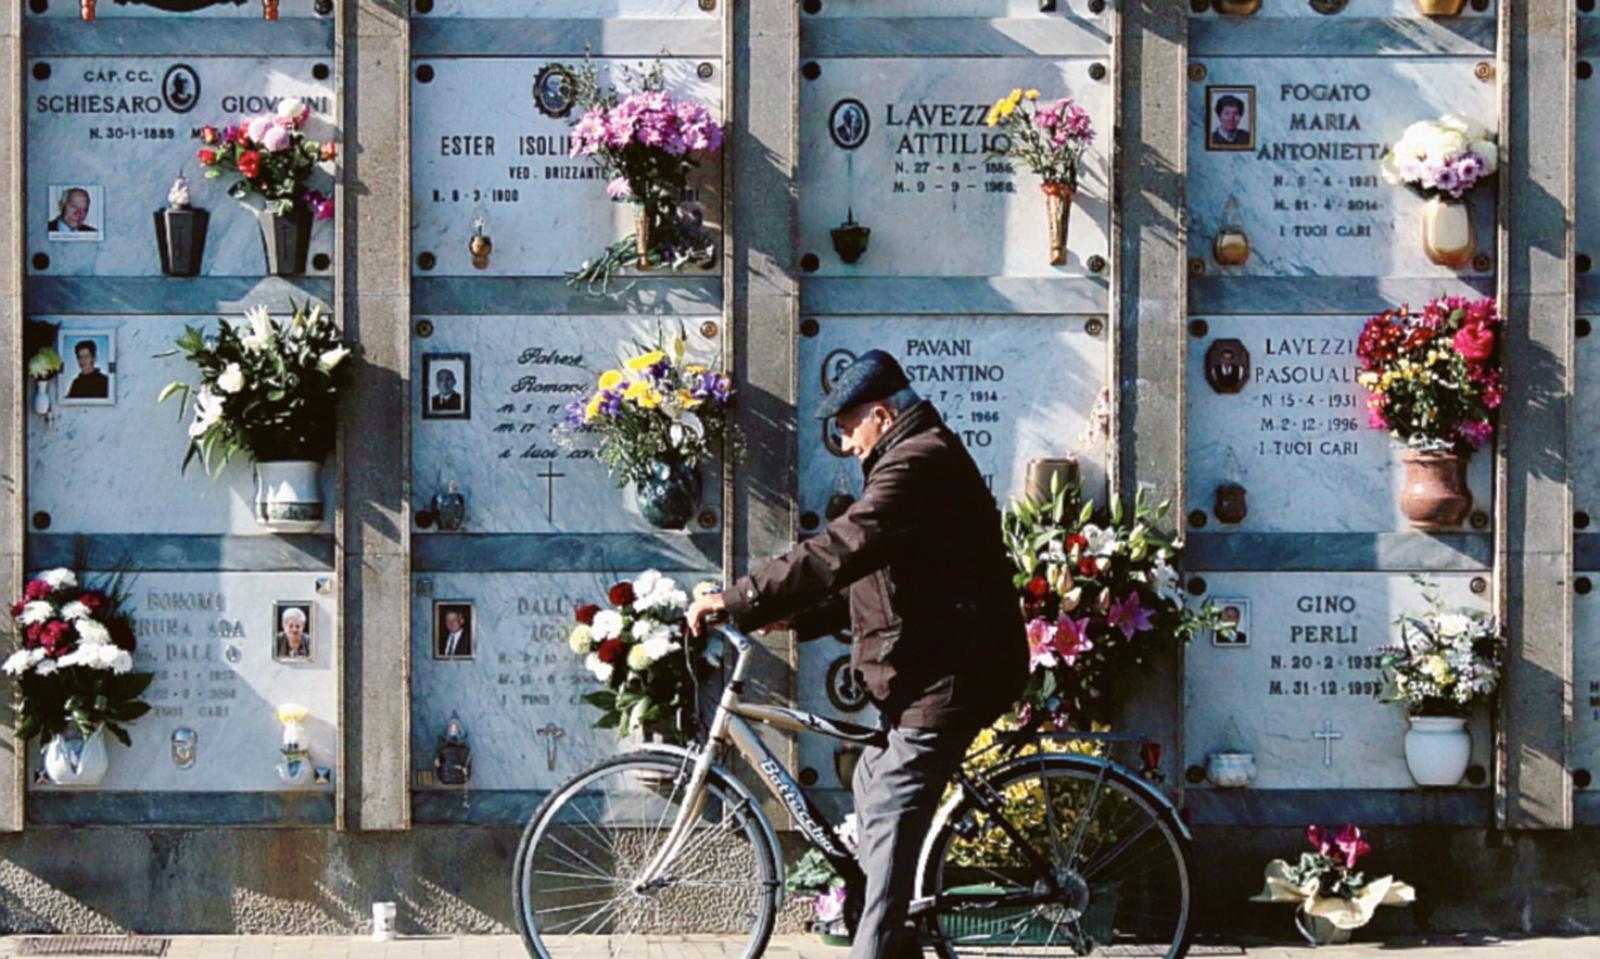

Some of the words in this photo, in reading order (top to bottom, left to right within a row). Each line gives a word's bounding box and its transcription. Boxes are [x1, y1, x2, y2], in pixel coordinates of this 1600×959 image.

[83, 70, 120, 82] CAP.
[1280, 84, 1371, 102] FOGATO
[37, 95, 162, 113] SCHIESARO
[221, 95, 328, 114] GIOVNI
[886, 103, 1011, 127] LAVEZZ
[1289, 113, 1361, 131] MARIA
[440, 135, 495, 156] ESTER
[519, 135, 588, 156] ISOLI
[1256, 142, 1391, 161] ANTONIETTA
[1294, 225, 1327, 237] TUOI
[1335, 225, 1372, 238] CARI
[906, 339, 971, 356] PAVANI
[1265, 338, 1353, 356] LAVEZZI
[906, 365, 1005, 382] STANTINO
[970, 391, 998, 402] 1914
[971, 412, 999, 423] 1966
[1273, 441, 1312, 456] TUOI
[1319, 441, 1358, 456] CARI
[1296, 596, 1356, 613] GINO
[137, 618, 192, 637] RUNA
[1290, 625, 1358, 643] PERLI
